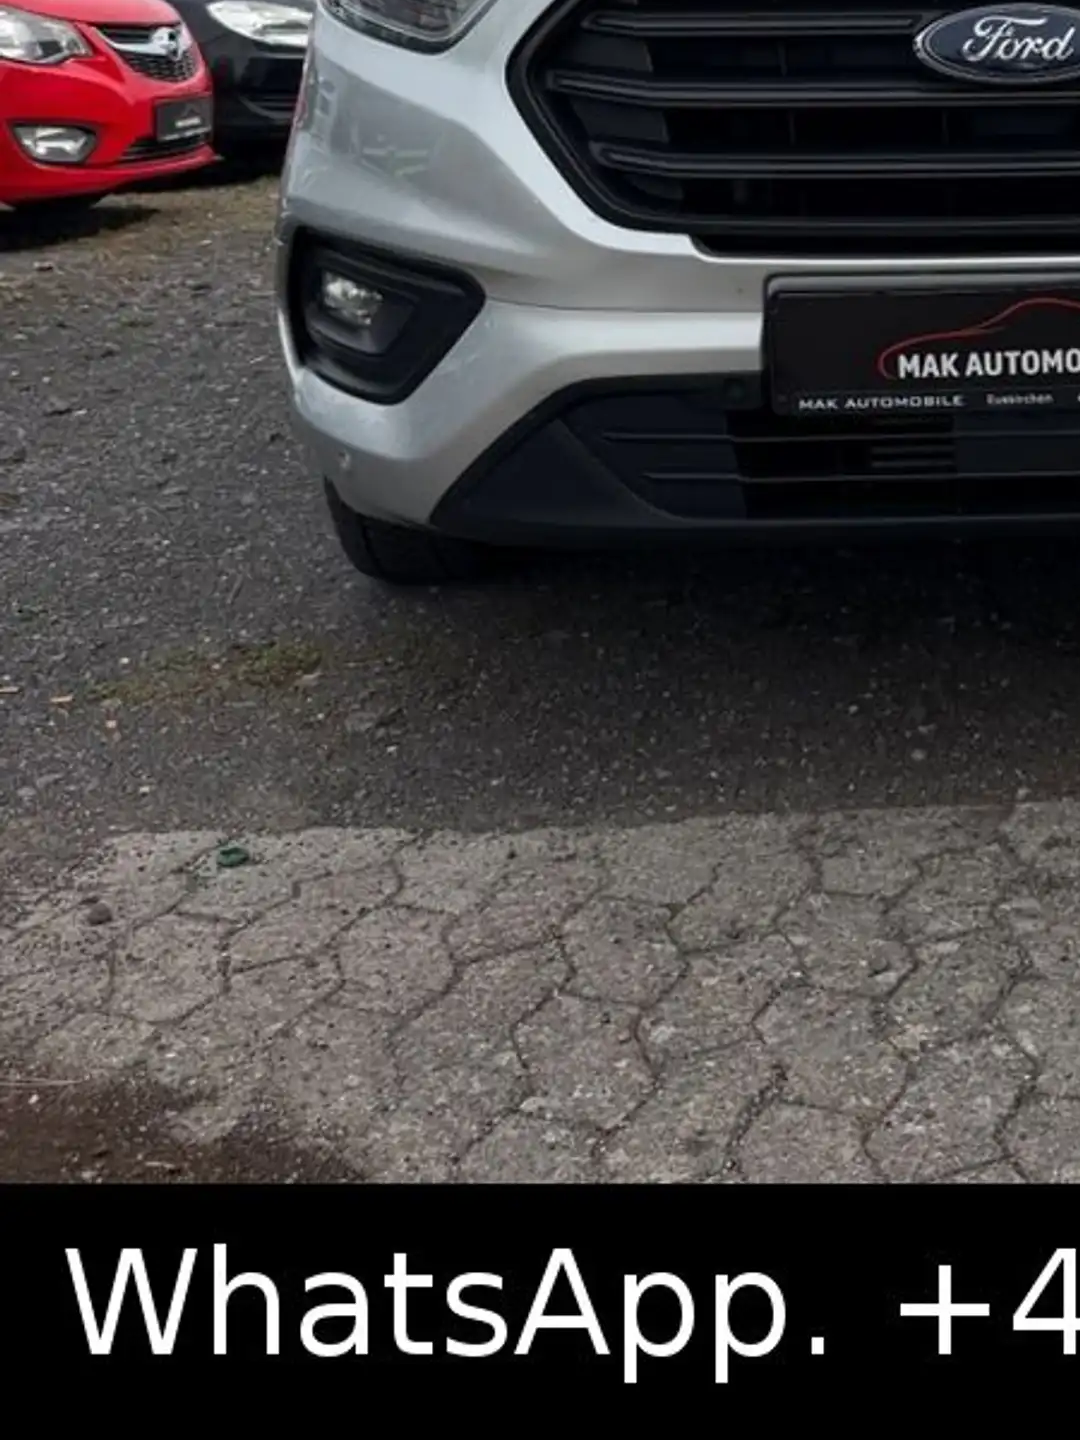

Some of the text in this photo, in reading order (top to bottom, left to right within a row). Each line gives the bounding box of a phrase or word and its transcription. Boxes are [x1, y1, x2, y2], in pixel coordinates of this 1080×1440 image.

[961, 15, 1076, 62] Ford
[898, 352, 959, 379] MAK
[798, 398, 838, 409] MAK
[844, 395, 964, 409] AUTOMOBILE
